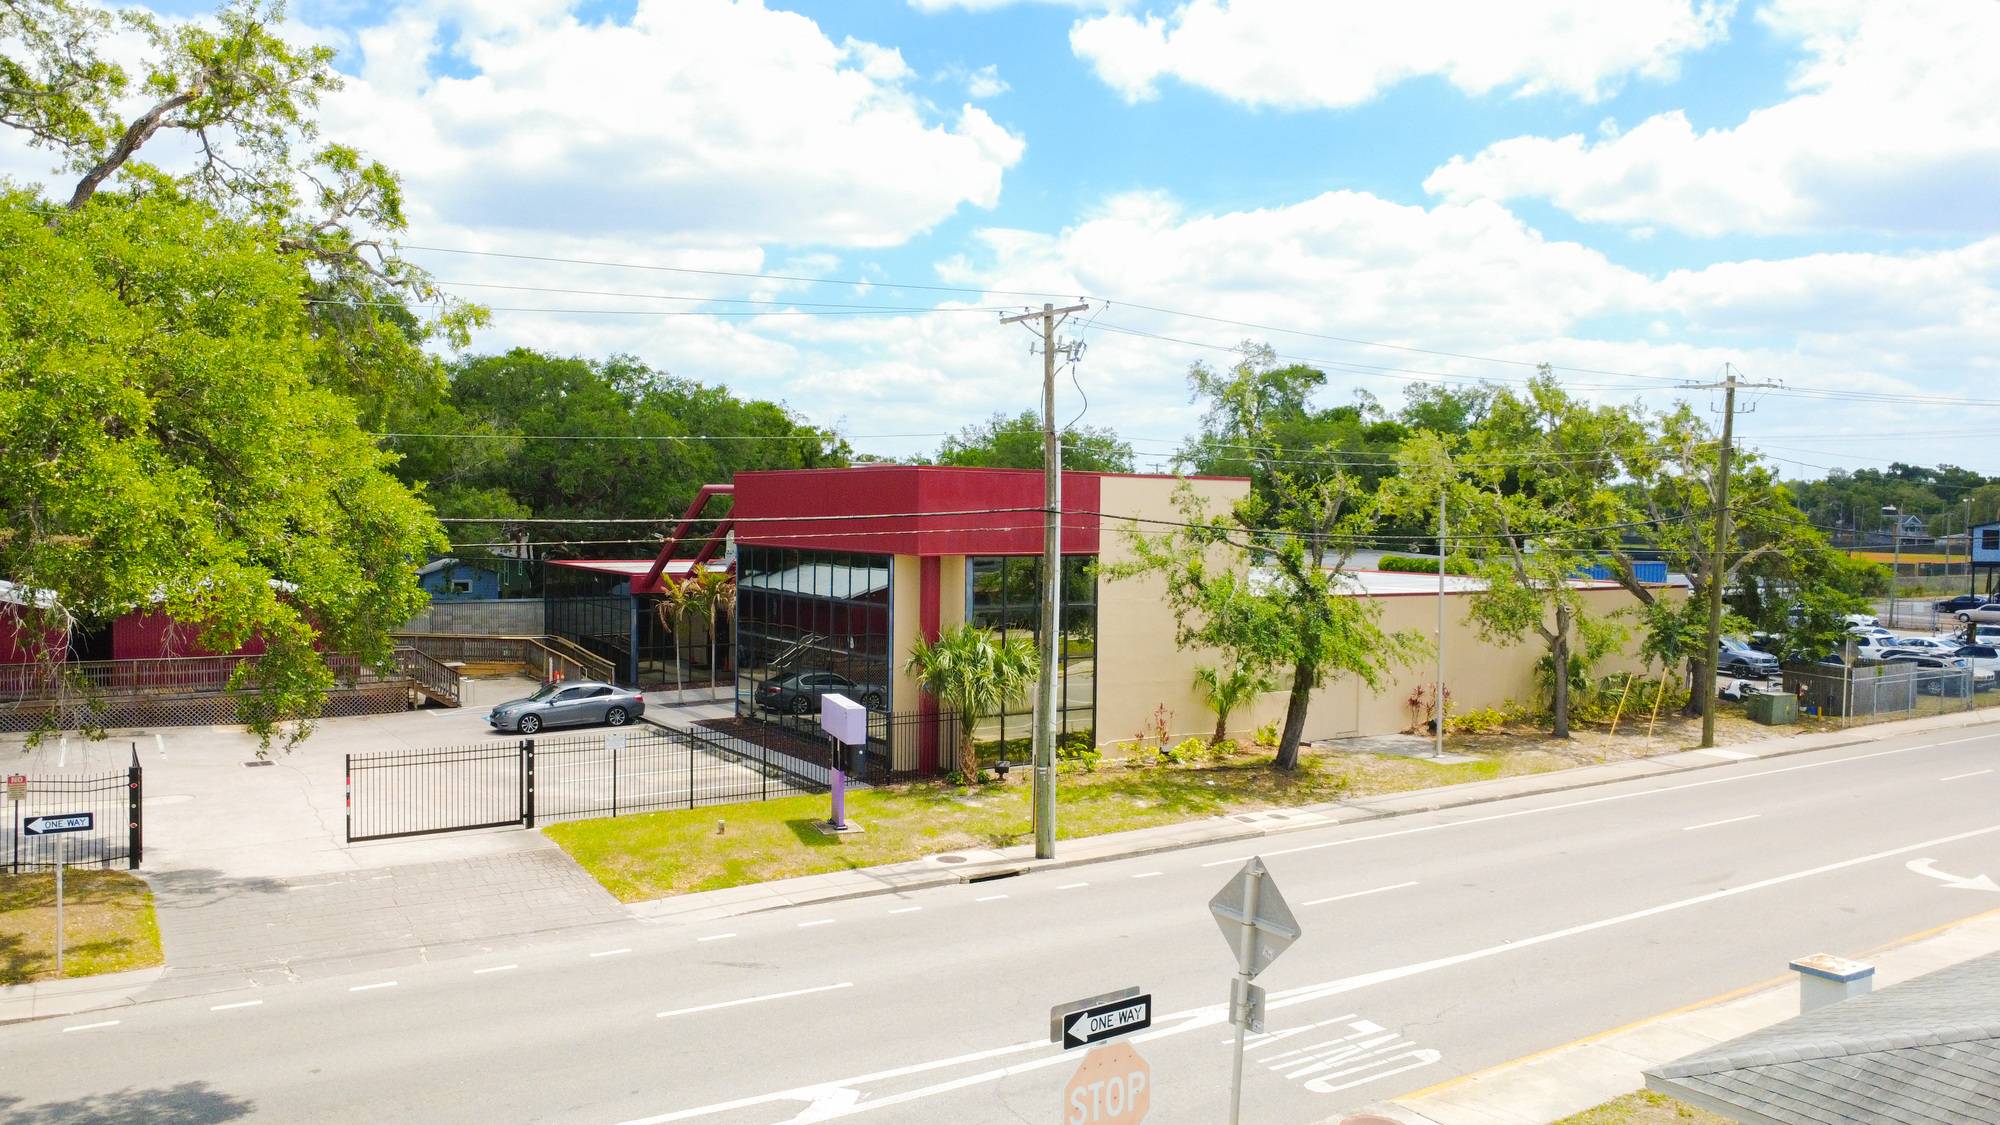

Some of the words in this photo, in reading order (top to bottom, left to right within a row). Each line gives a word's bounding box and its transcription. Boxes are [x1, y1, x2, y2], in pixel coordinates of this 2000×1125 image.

[44, 820, 64, 828] ONE
[67, 818, 86, 826] WAY
[1090, 1014, 1114, 1032] ONE
[1118, 1007, 1143, 1025] WAY
[1221, 1013, 1442, 1093] ONLY
[1069, 1071, 1146, 1125] STOP
